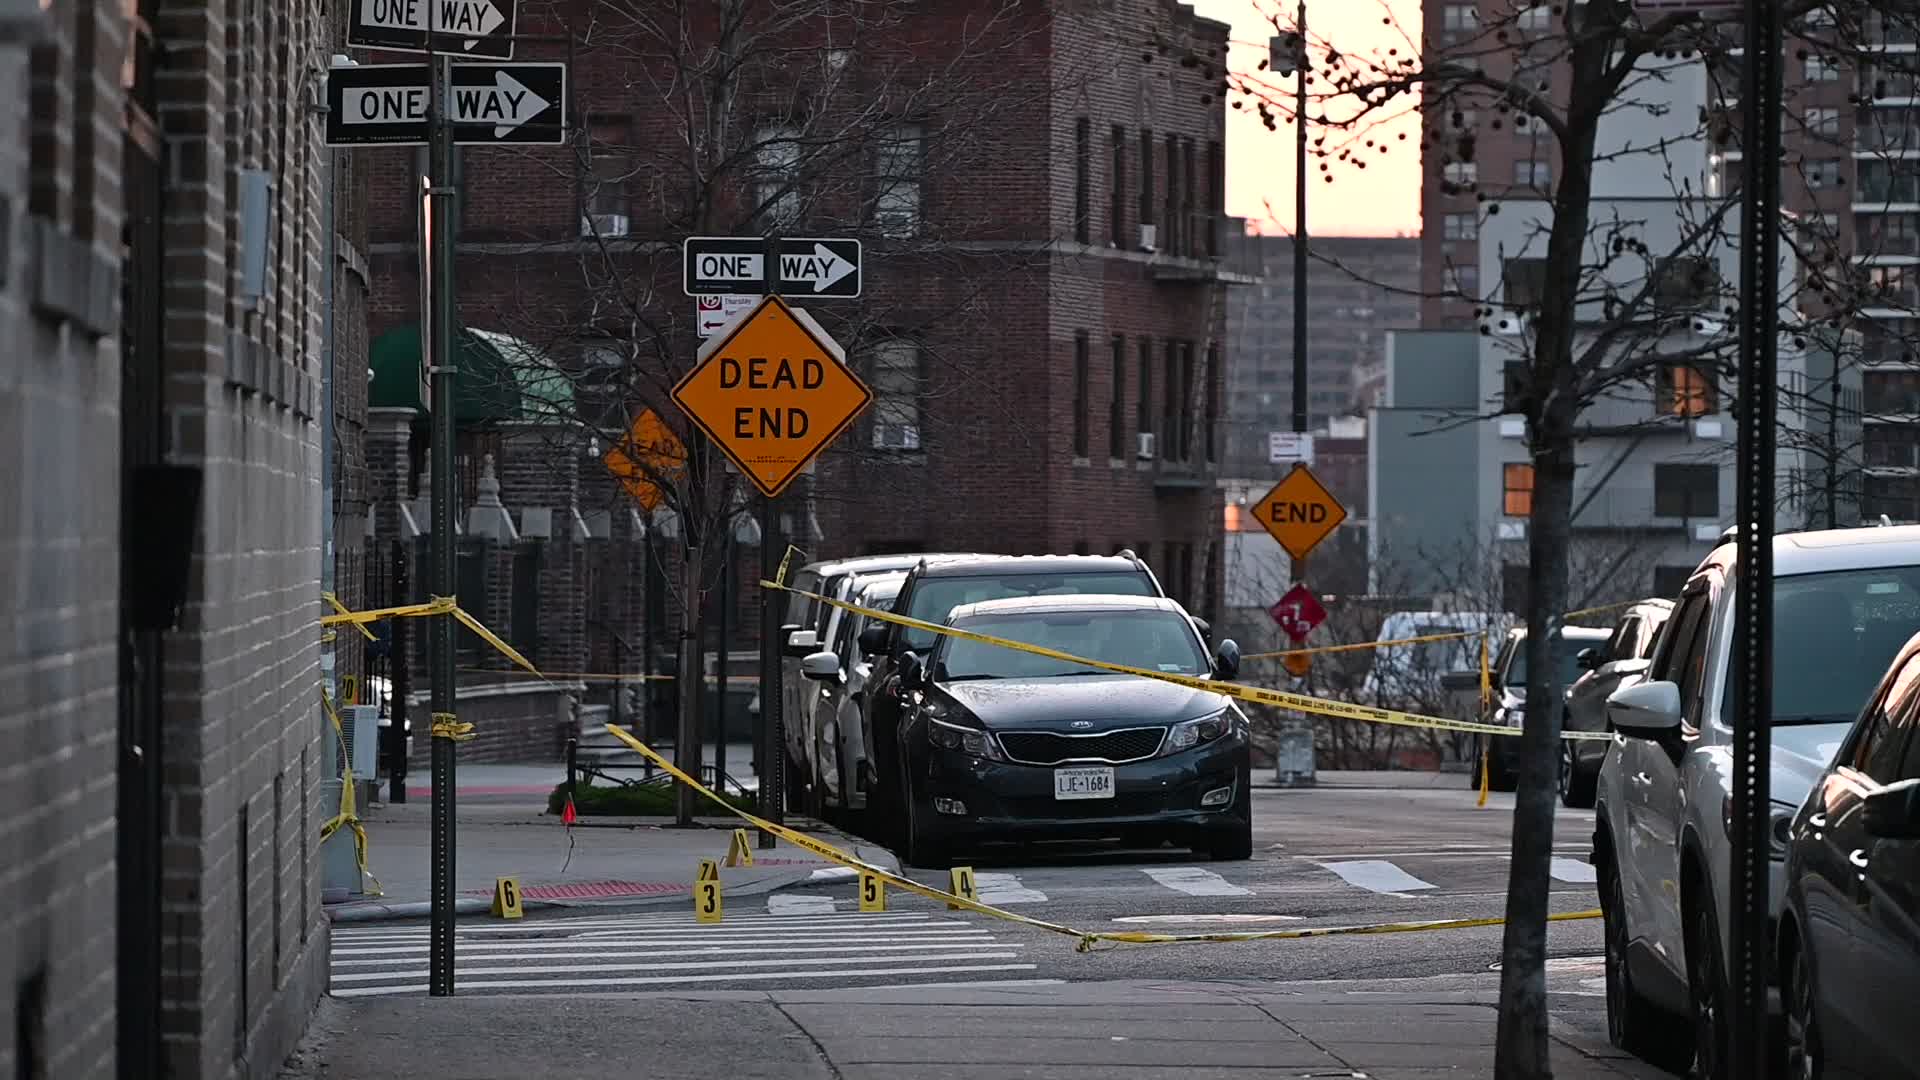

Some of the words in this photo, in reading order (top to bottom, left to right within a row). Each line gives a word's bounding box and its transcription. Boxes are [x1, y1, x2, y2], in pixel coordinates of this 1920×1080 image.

[373, 0, 418, 26] ONE
[441, 0, 489, 32] WAY
[360, 90, 423, 120] ONE
[456, 90, 527, 119] WAY
[702, 256, 752, 278] ONE
[782, 257, 836, 279] WAY
[720, 358, 824, 389] DEAD
[735, 407, 809, 439] END
[1271, 502, 1327, 523] END
[739, 832, 749, 857] 8
[701, 863, 709, 880] 7
[961, 871, 972, 898] 4
[504, 880, 515, 908] 6
[704, 884, 715, 913] 3
[864, 875, 876, 902] 5
